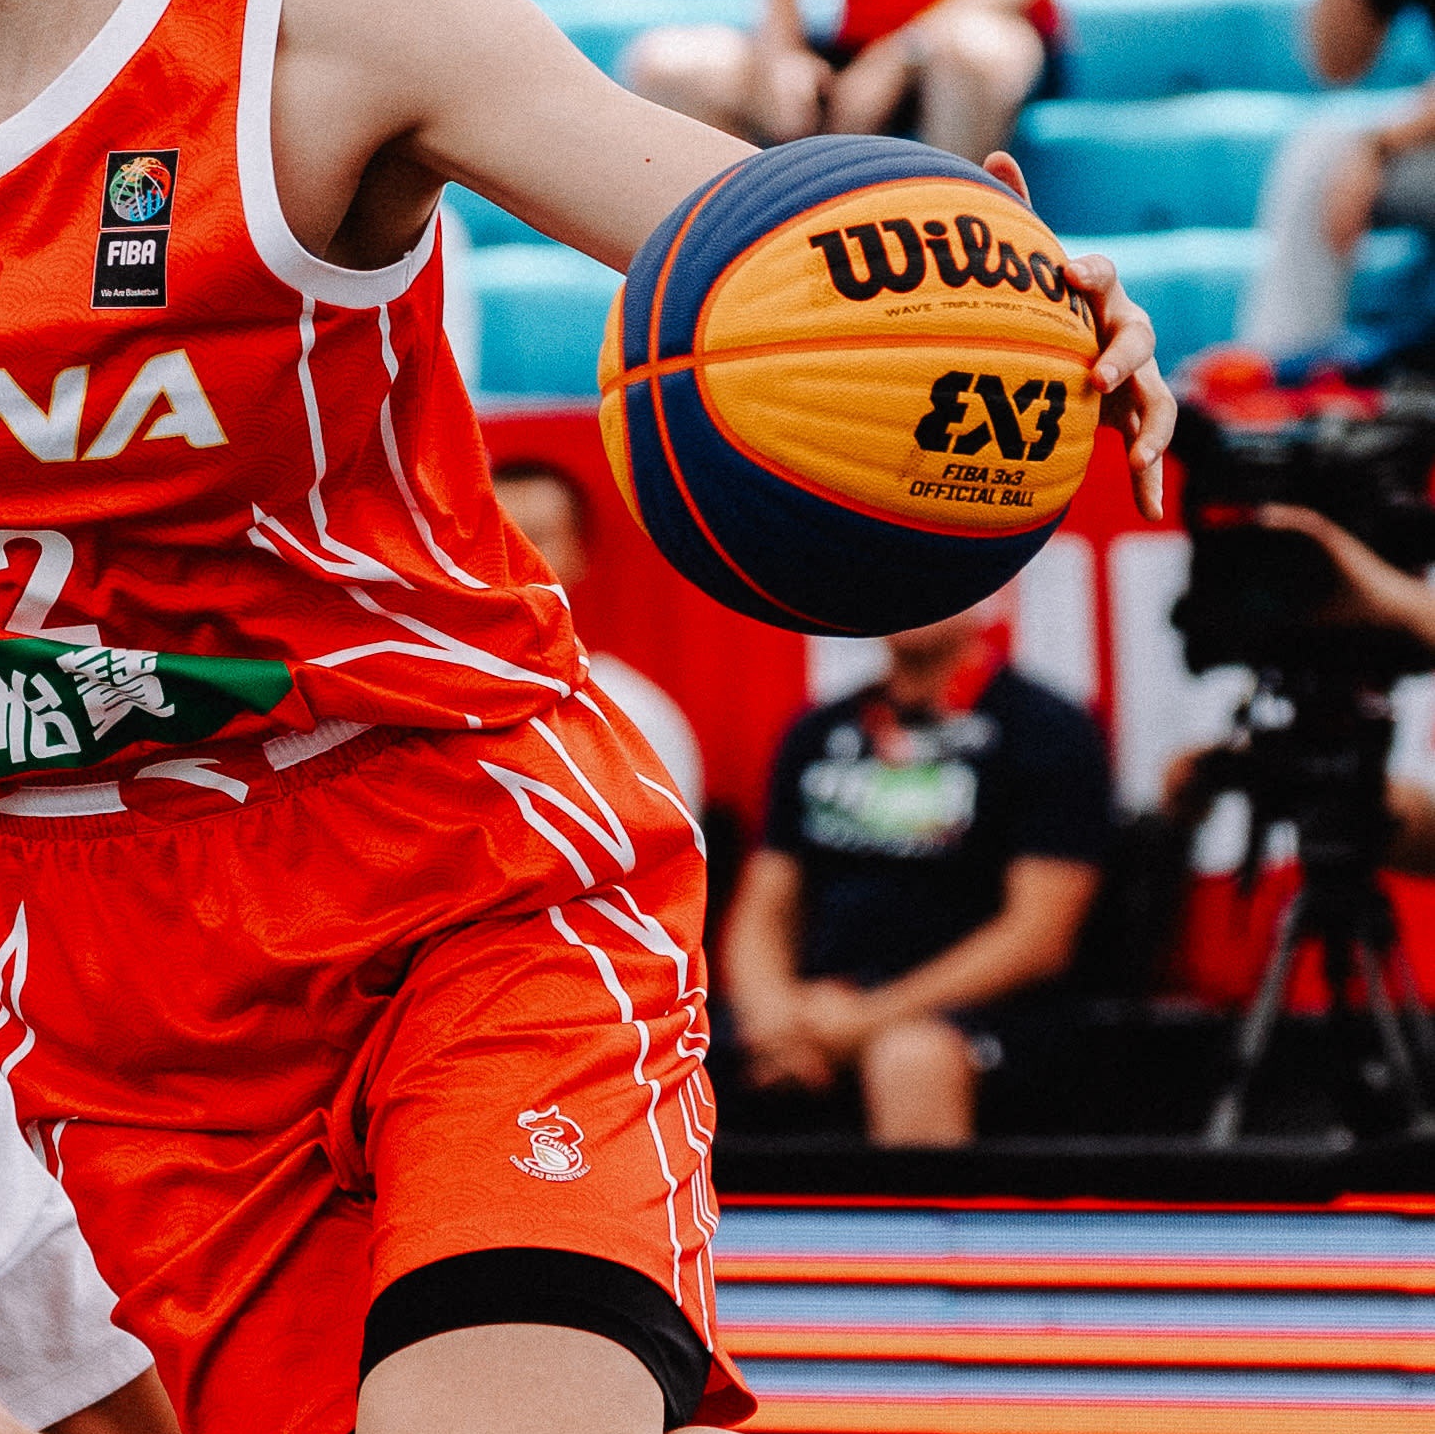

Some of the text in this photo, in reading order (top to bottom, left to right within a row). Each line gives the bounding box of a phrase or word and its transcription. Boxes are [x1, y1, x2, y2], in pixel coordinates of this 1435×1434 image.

[107, 239, 157, 267] FIBA
[126, 287, 159, 297] Basketball
[885, 302, 933, 317] WAVE
[940, 300, 980, 310] TRIPLE
[941, 463, 989, 483] FIBA
[909, 480, 1036, 508] OFFICIAL BALL
